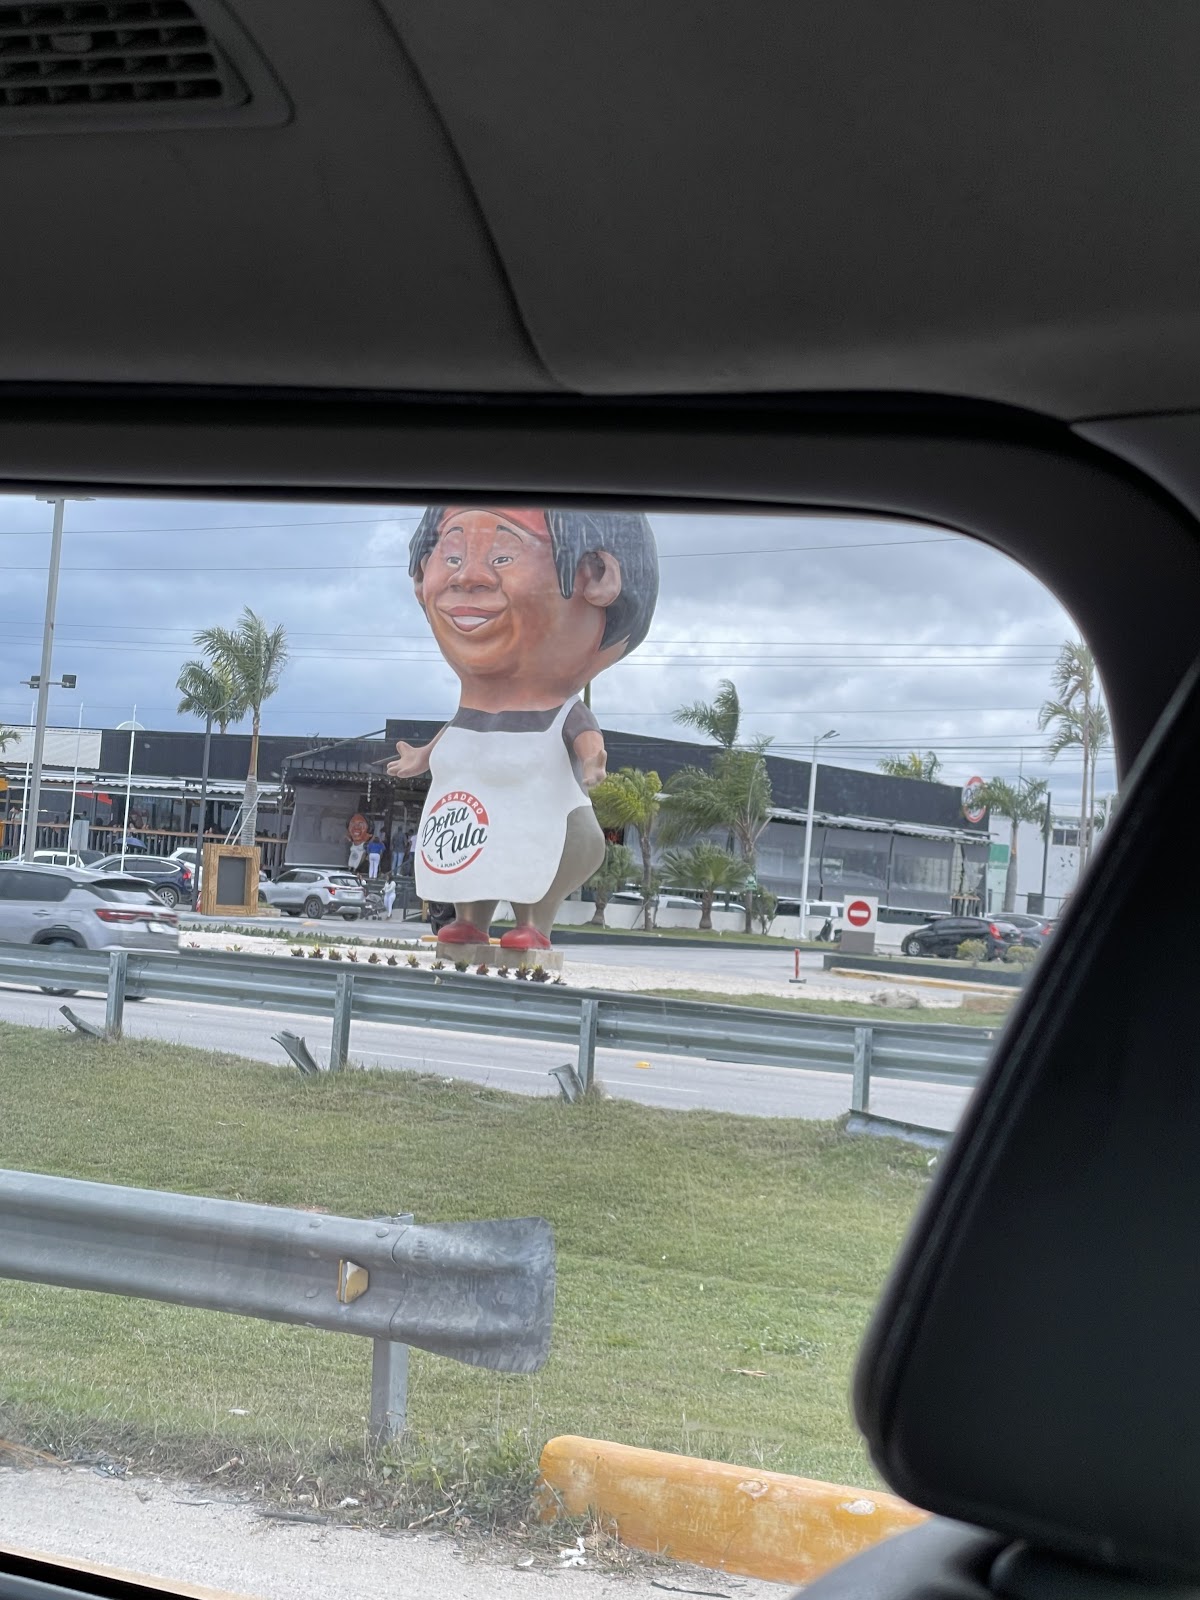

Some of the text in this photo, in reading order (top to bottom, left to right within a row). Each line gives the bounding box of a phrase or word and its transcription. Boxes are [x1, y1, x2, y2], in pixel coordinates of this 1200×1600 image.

[441, 793, 484, 815] ASADERO
[422, 806, 470, 847] Doña
[435, 822, 488, 860] Pula
